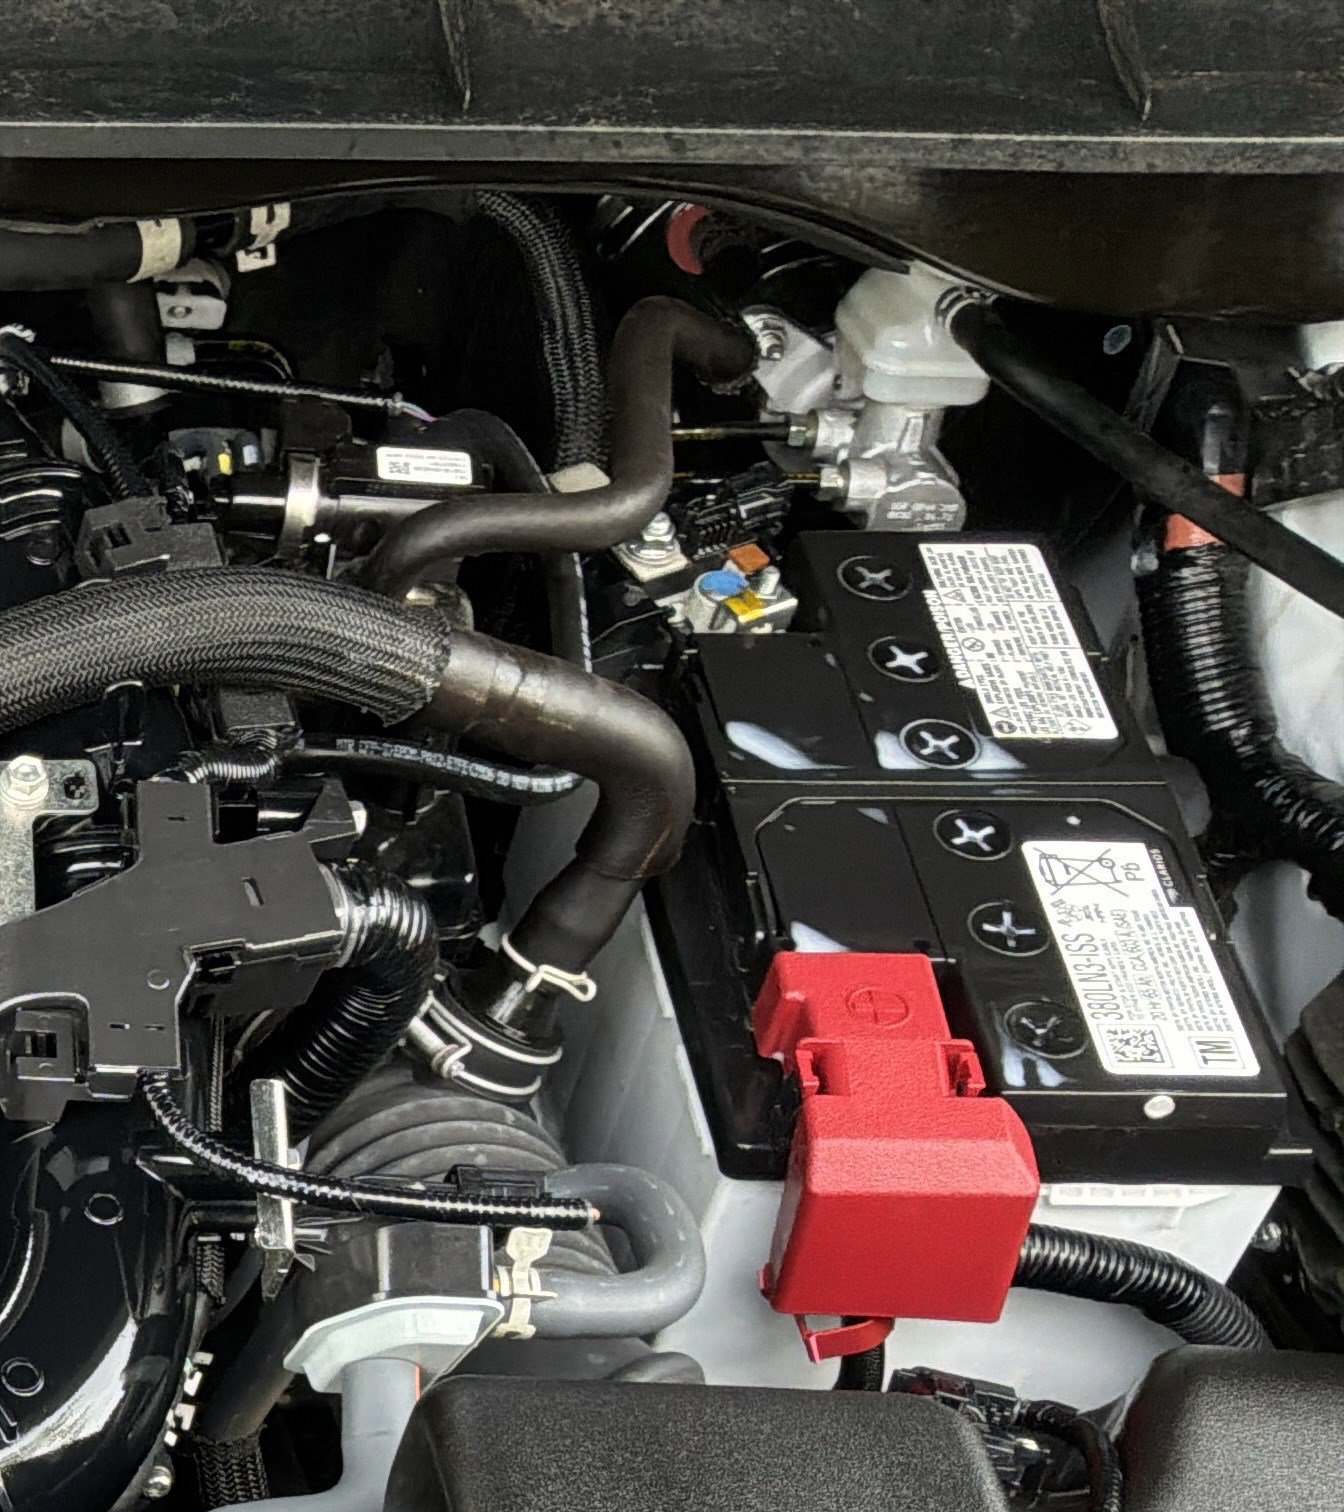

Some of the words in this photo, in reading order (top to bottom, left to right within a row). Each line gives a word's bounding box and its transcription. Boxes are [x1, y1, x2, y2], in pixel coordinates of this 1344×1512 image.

[1121, 862, 1145, 881] Pb
[1061, 932, 1124, 1021] 380LN3-ISS
[1194, 1039, 1238, 1066] TM
